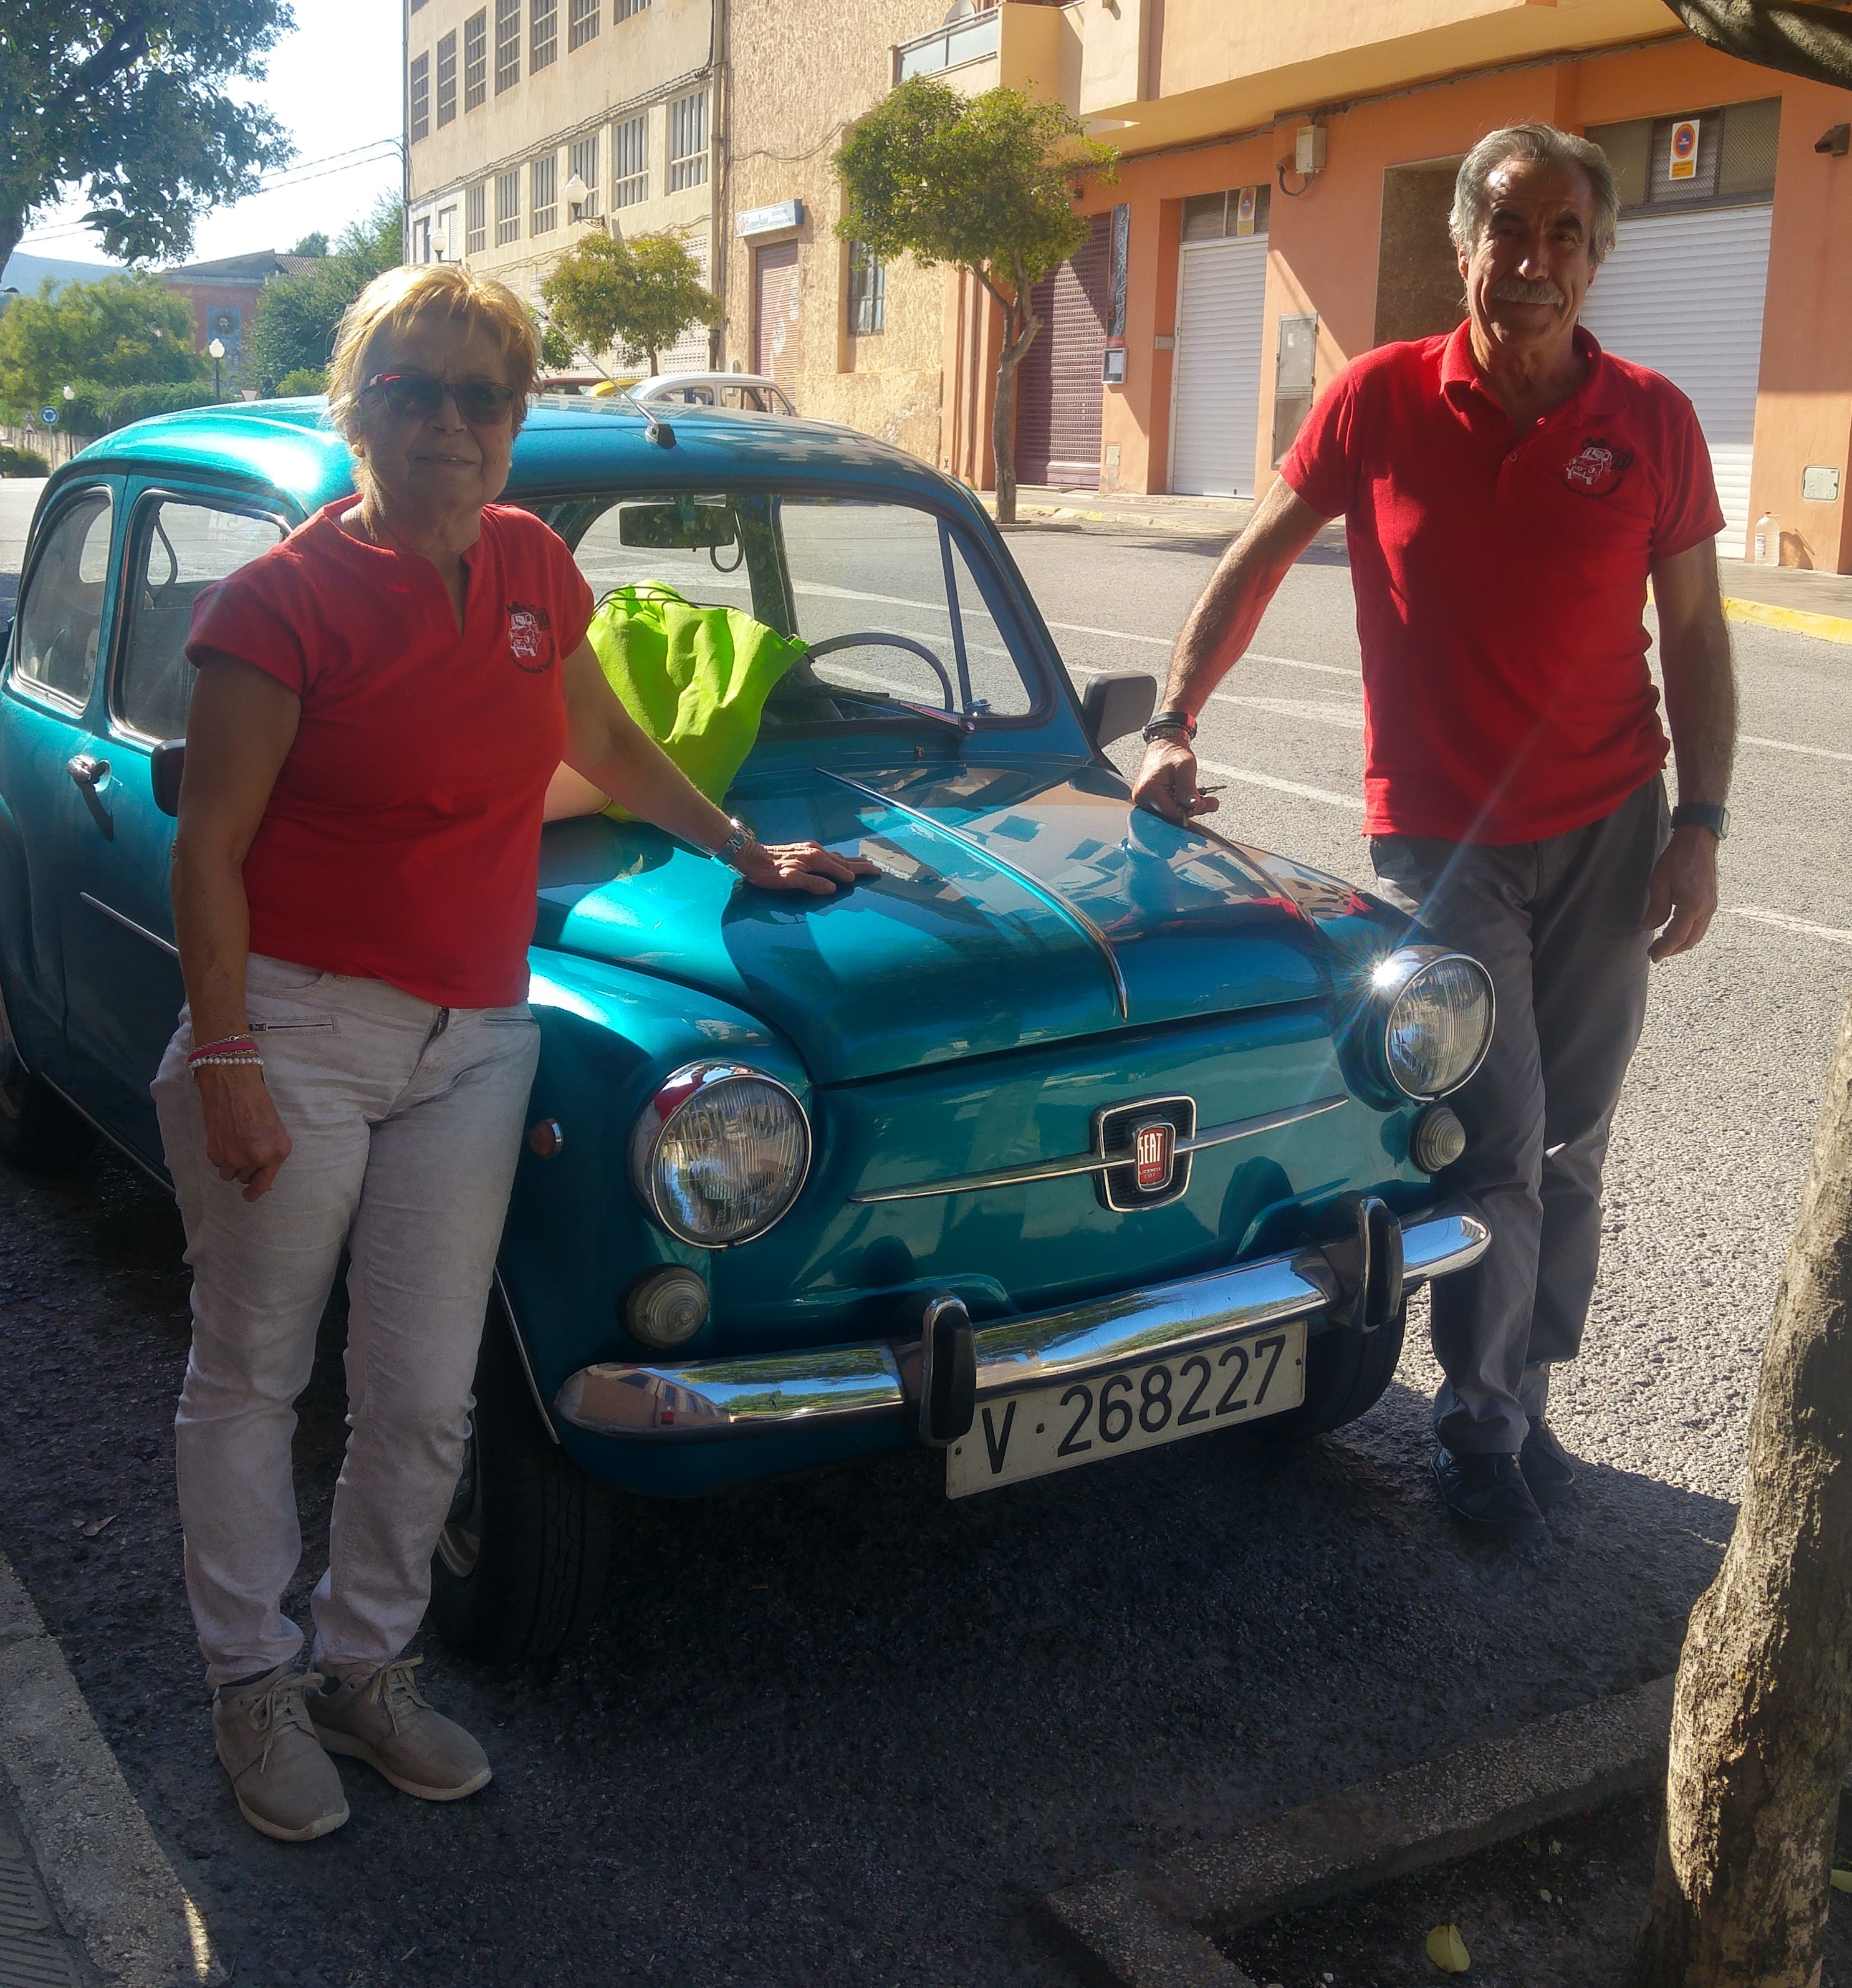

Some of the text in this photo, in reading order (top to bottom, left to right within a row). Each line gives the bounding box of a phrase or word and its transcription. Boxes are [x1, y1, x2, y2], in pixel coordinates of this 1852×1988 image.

[1139, 1133, 1162, 1164] SEAT
[981, 1334, 1286, 1474] V 268227
